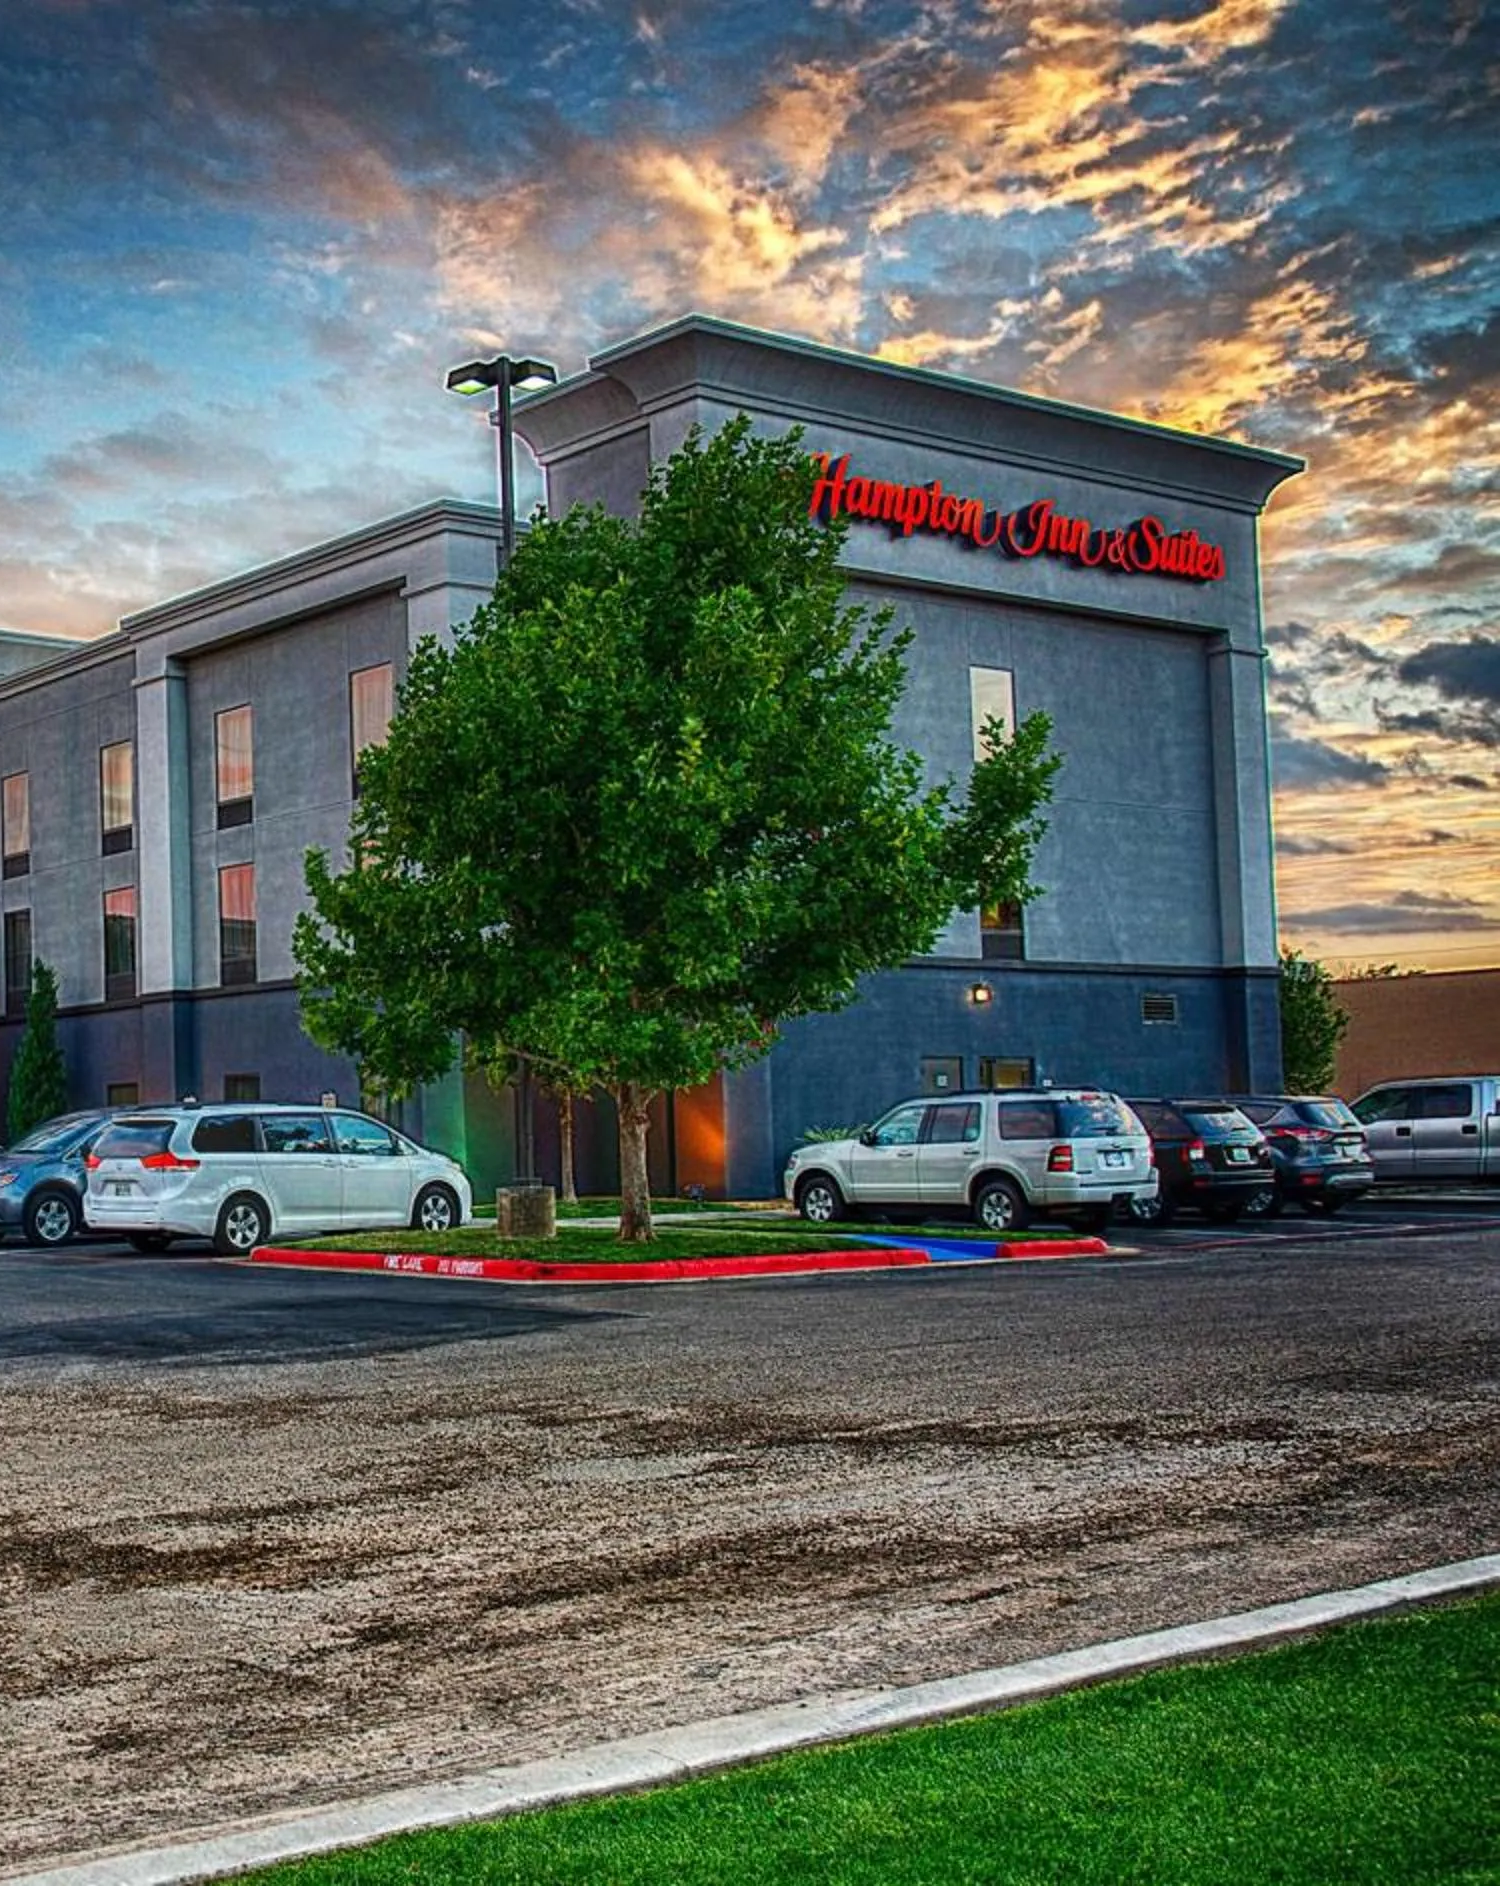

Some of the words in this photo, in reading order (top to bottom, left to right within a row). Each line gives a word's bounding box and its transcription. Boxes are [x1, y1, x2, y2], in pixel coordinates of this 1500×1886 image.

[808, 451, 1001, 547] Hampton
[1007, 498, 1107, 567] Inn
[1128, 514, 1226, 580] Suites
